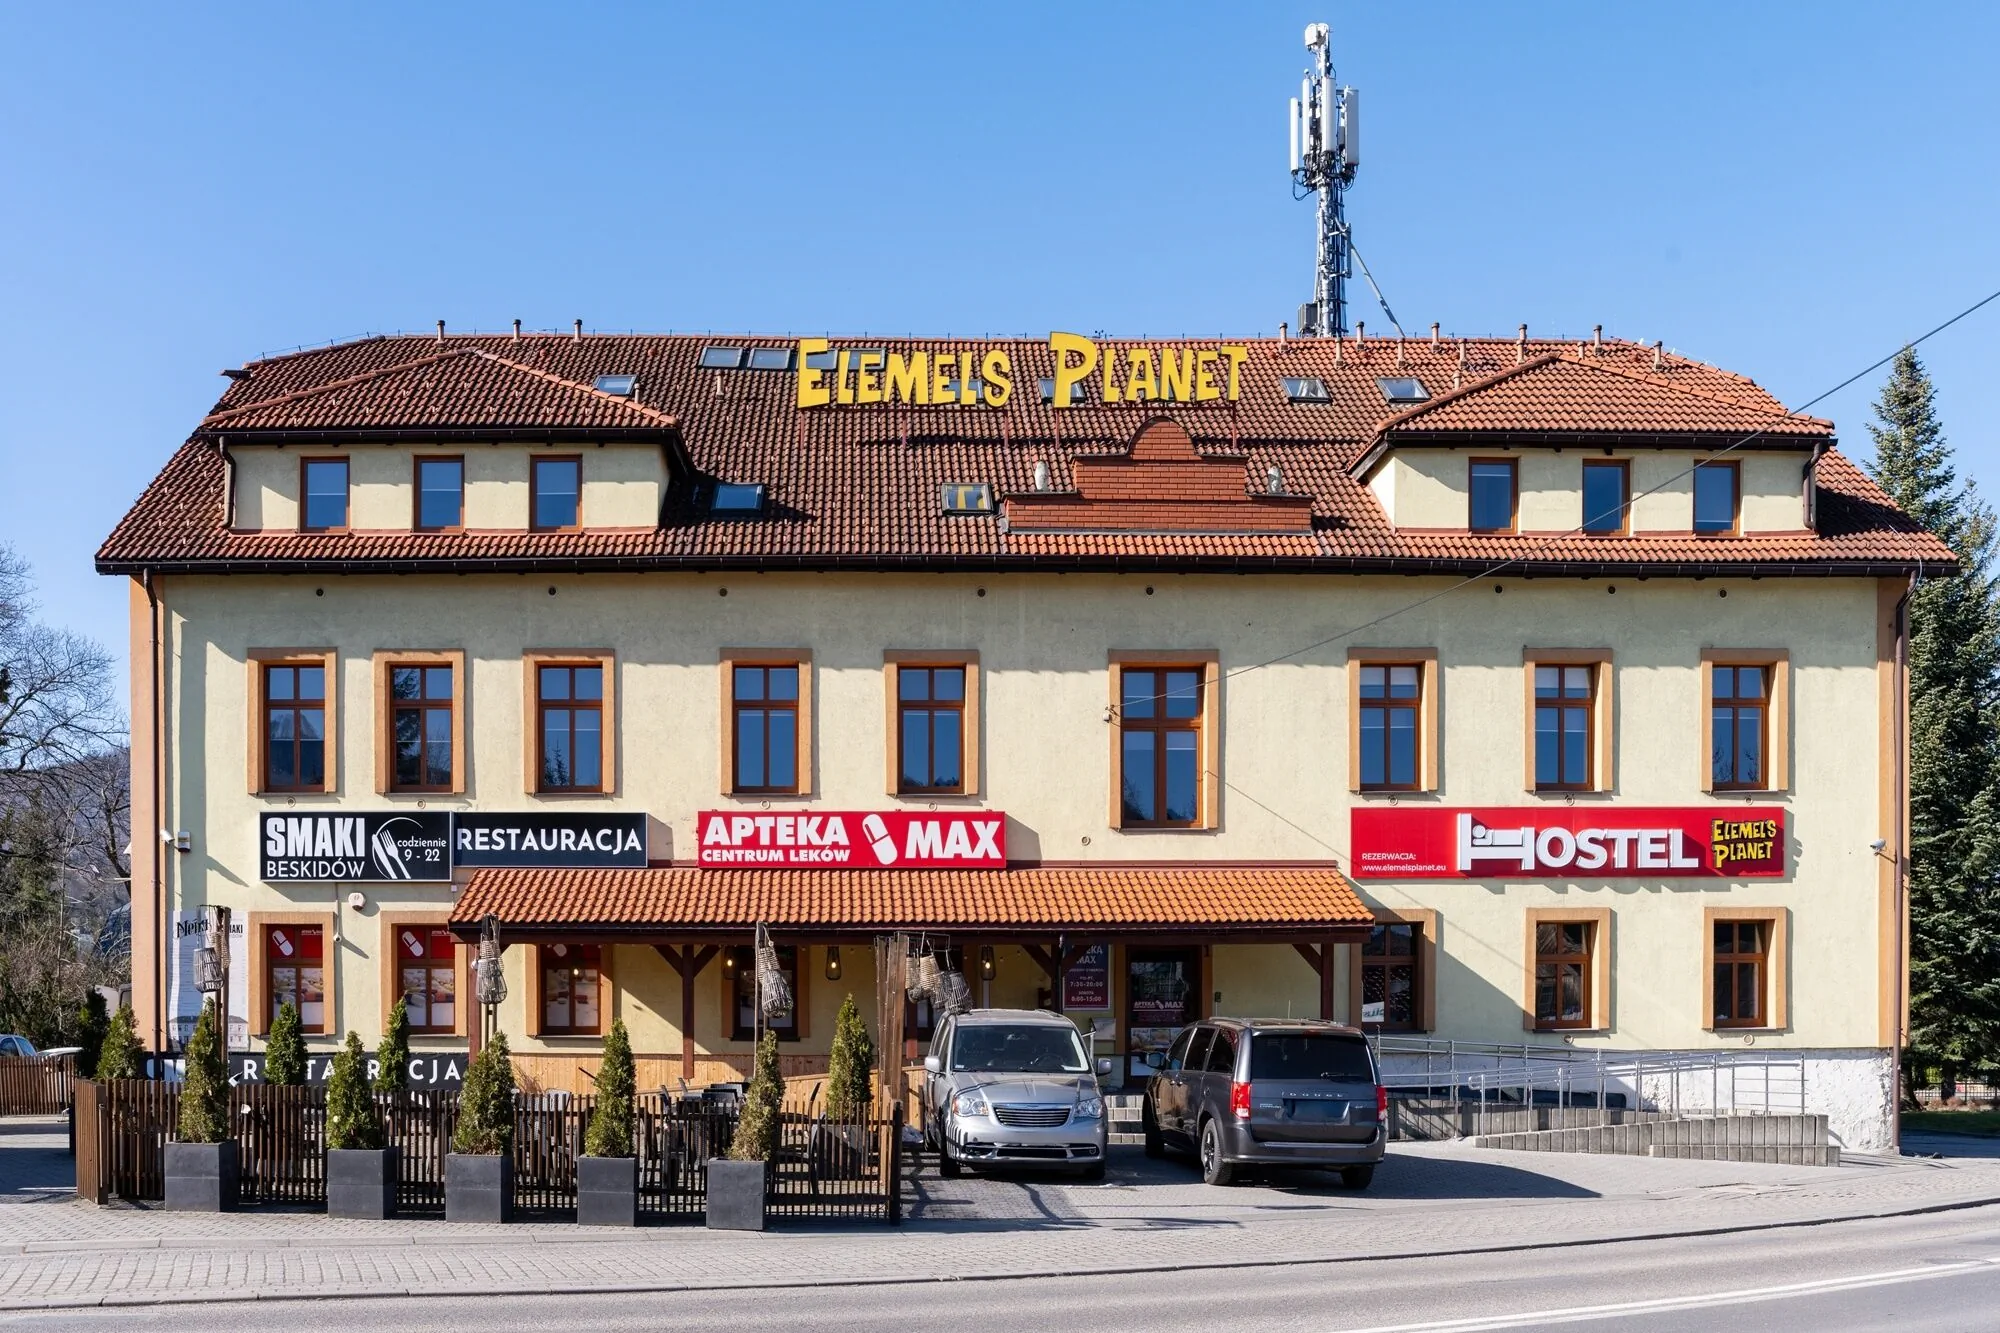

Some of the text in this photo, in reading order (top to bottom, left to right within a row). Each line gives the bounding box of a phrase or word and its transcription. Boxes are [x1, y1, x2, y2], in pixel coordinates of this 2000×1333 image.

[1049, 331, 1249, 408] PLANET
[266, 817, 366, 858] SMAKI
[397, 835, 447, 848] codziennie
[457, 828, 643, 852] RESTAURACJA
[703, 816, 1003, 859] APTEKA MAX
[1456, 812, 1700, 871] HOSTEL
[404, 848, 412, 862] 9
[424, 848, 441, 862] 22
[701, 846, 851, 863] CENTRUM LEKÓW
[1361, 852, 1417, 861] REZERWACJA:
[1713, 841, 1774, 869] PLANET
[266, 859, 365, 878] BESKIDÓW
[1361, 863, 1447, 873] www.elemelsplanet.eu
[1164, 1001, 1184, 1009] MAX
